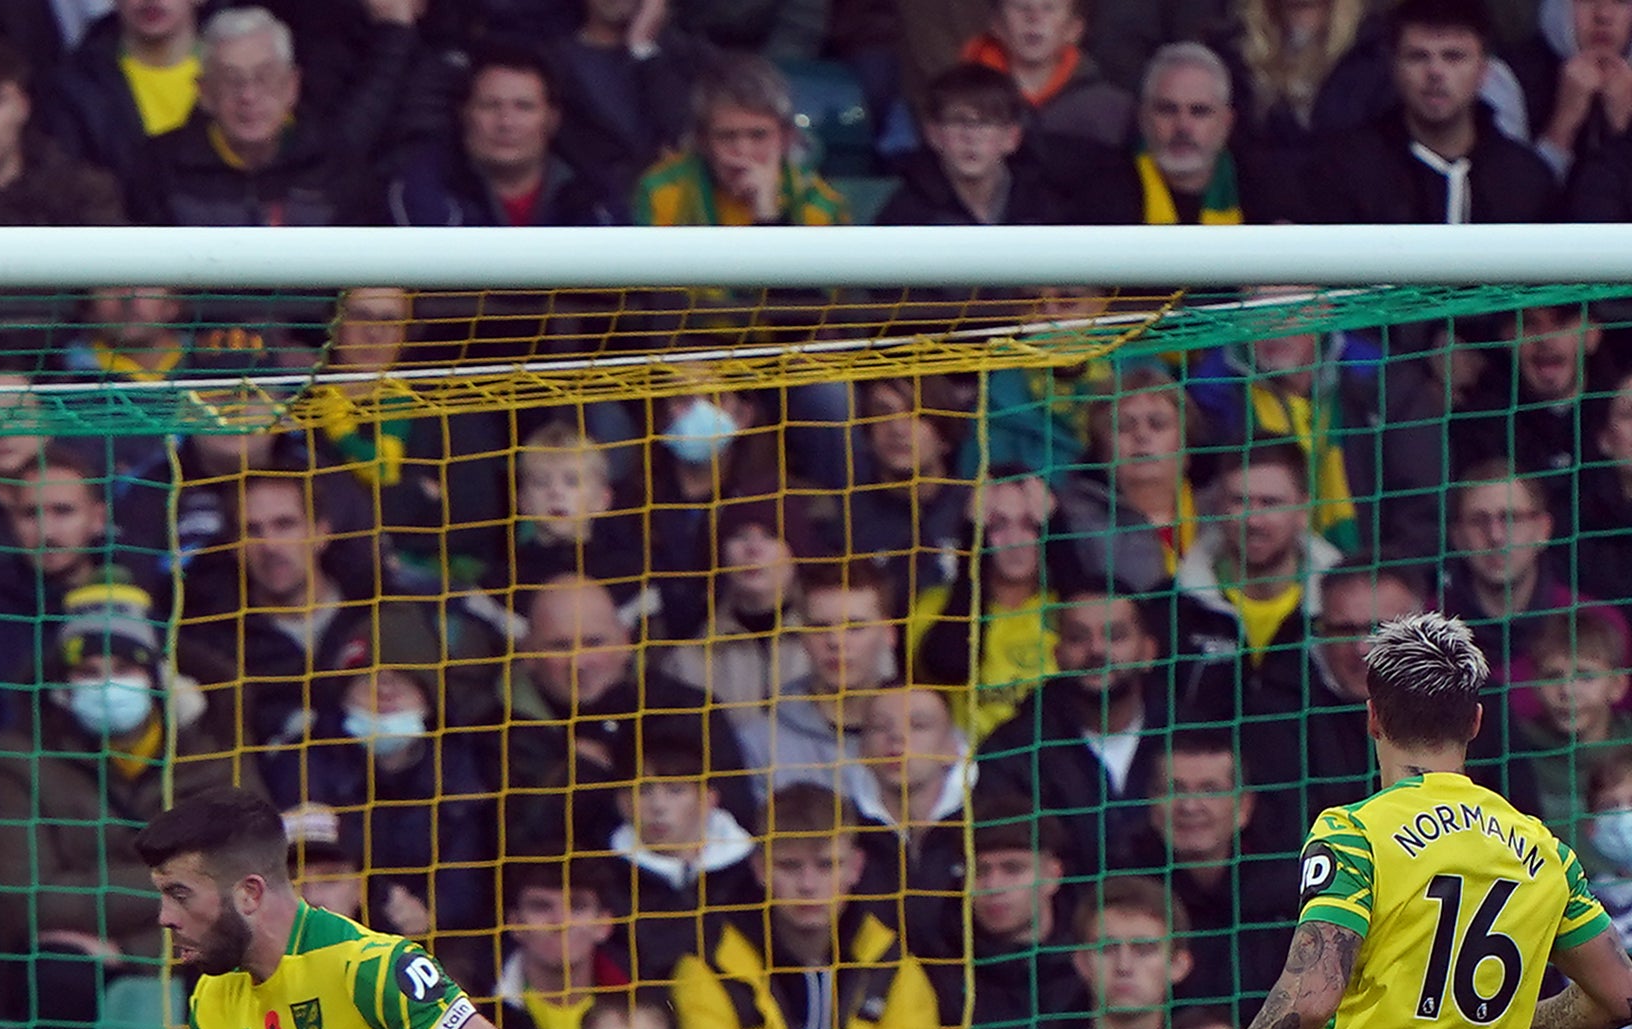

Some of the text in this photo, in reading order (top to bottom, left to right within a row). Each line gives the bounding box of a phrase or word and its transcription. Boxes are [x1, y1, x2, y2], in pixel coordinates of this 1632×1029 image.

[1393, 803, 1545, 878] NORMANN
[405, 957, 439, 1000] JD
[1414, 874, 1522, 1025] 16
